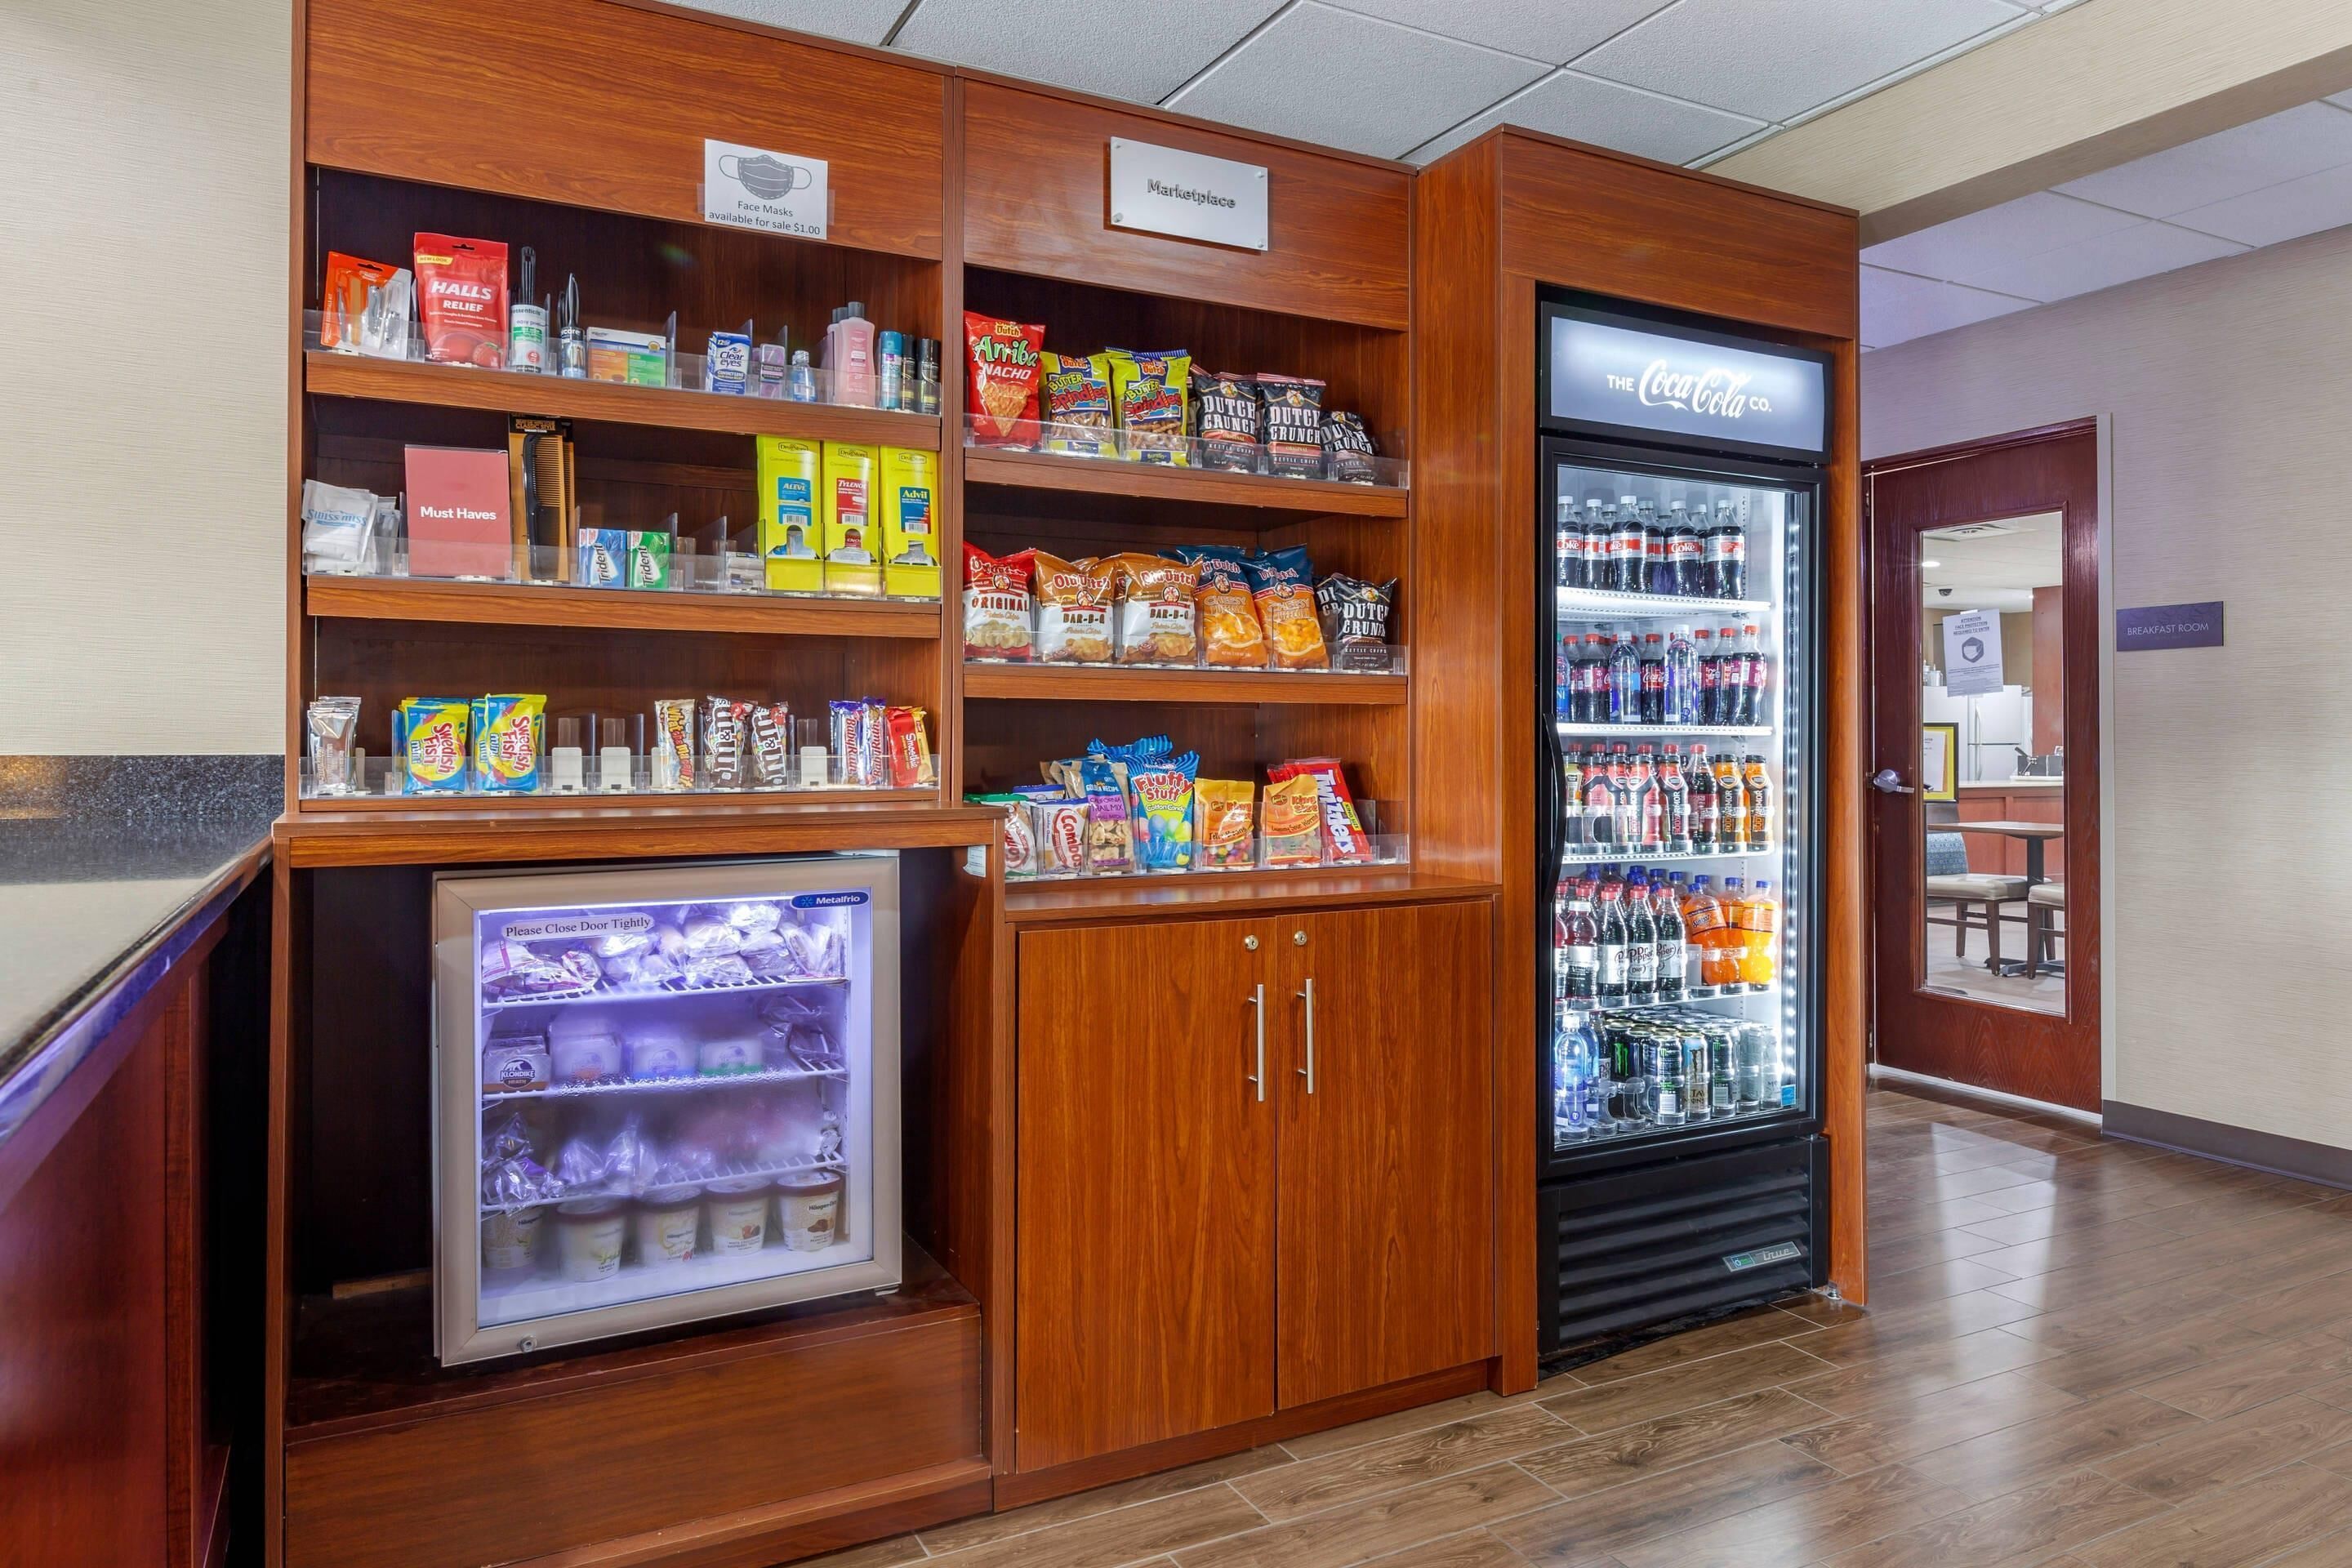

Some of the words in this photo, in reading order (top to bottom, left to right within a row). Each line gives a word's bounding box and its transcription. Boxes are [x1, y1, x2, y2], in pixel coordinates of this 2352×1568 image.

[1147, 178, 1236, 209] Marketplace
[737, 201, 760, 212] Face
[763, 204, 794, 217] Masks
[709, 212, 753, 225] available
[755, 216, 770, 228] for
[772, 220, 791, 231] sale
[793, 223, 821, 235] $1.00
[430, 280, 492, 301] HALLS
[443, 300, 484, 313] RELIEF
[719, 351, 744, 360] Clear
[973, 336, 1039, 367] Arriba
[719, 359, 742, 368] eyes
[983, 363, 1032, 380] NACHO
[1048, 372, 1084, 392] BUTTER
[1125, 380, 1160, 400] BUTTER
[1606, 374, 1635, 392] THE
[1748, 395, 1773, 413] CO.
[1121, 390, 1183, 421] Spindles
[1202, 395, 1256, 419] DUTCH
[1204, 413, 1256, 435] CRUNCH
[1269, 406, 1321, 428] DUTCH
[1270, 425, 1321, 444] CRUNCH
[902, 489, 929, 500] Advil
[420, 506, 454, 518] Must
[457, 507, 497, 520] Haves
[1671, 542, 1695, 553] Coke
[592, 542, 612, 585] Trident
[637, 546, 655, 587] Trident
[1212, 559, 1241, 574] Dutch
[1054, 573, 1078, 589] Old
[1164, 568, 1196, 588] Dutch
[971, 595, 1029, 612] ORIGINAL
[1062, 612, 1105, 625] BAR-B-Q
[2127, 624, 2176, 636] BREAKFAST
[2178, 622, 2210, 632] ROOM
[423, 734, 439, 765] Fish
[433, 722, 457, 774] Swedish
[501, 731, 518, 760] Fish
[511, 715, 532, 772] Swedish
[906, 733, 921, 769] Smoothie
[1134, 770, 1194, 795] Fluffy
[1145, 786, 1181, 803] Stuff
[1111, 803, 1124, 811] MIX
[1167, 804, 1186, 813] Candy
[1061, 814, 1083, 868] Combos
[816, 895, 861, 905] Metalfrio
[506, 926, 542, 937] Please
[545, 923, 577, 933] Close
[581, 920, 608, 931] Door
[612, 917, 651, 930] Tightly
[500, 1069, 536, 1082] KLONDIKE
